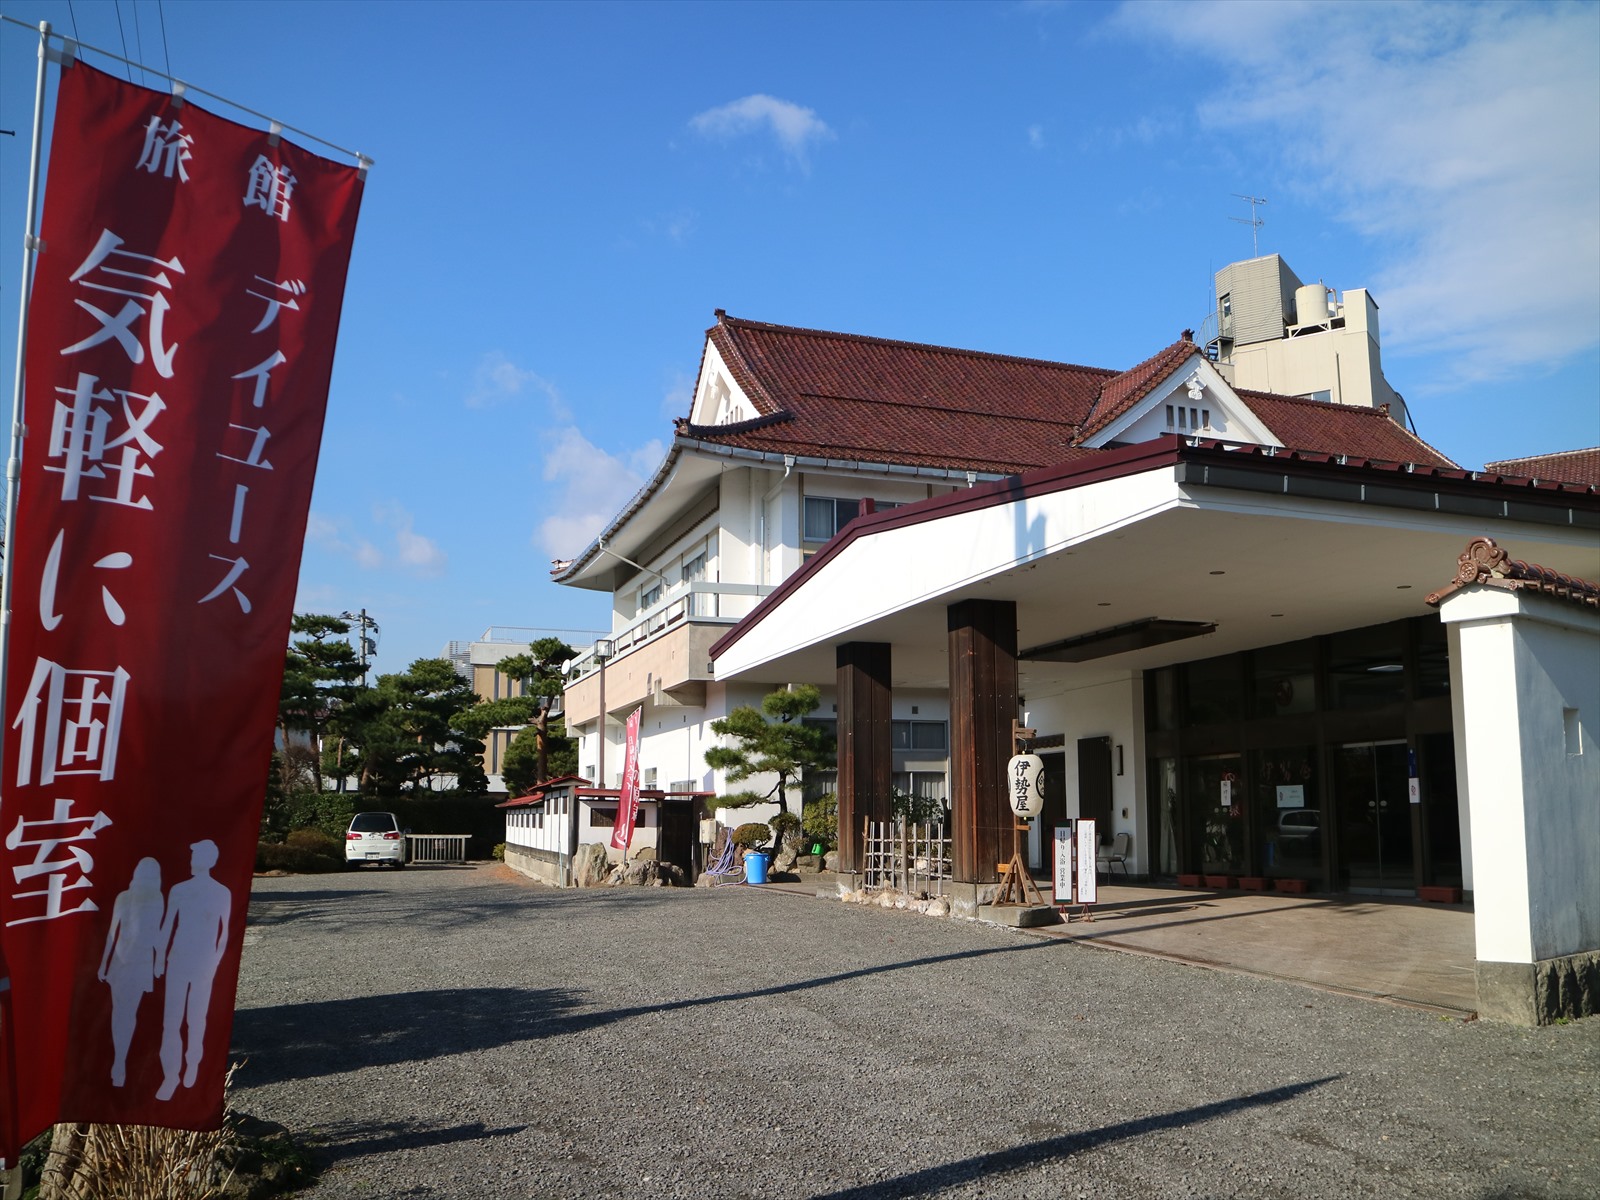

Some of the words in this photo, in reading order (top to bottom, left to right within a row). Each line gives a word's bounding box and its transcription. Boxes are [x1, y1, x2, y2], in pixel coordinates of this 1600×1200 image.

[136, 114, 298, 224] 旅館
[198, 273, 307, 615] デイユース
[5, 227, 186, 928] 気軽に個室
[1014, 759, 1031, 812] 伊勢屋
